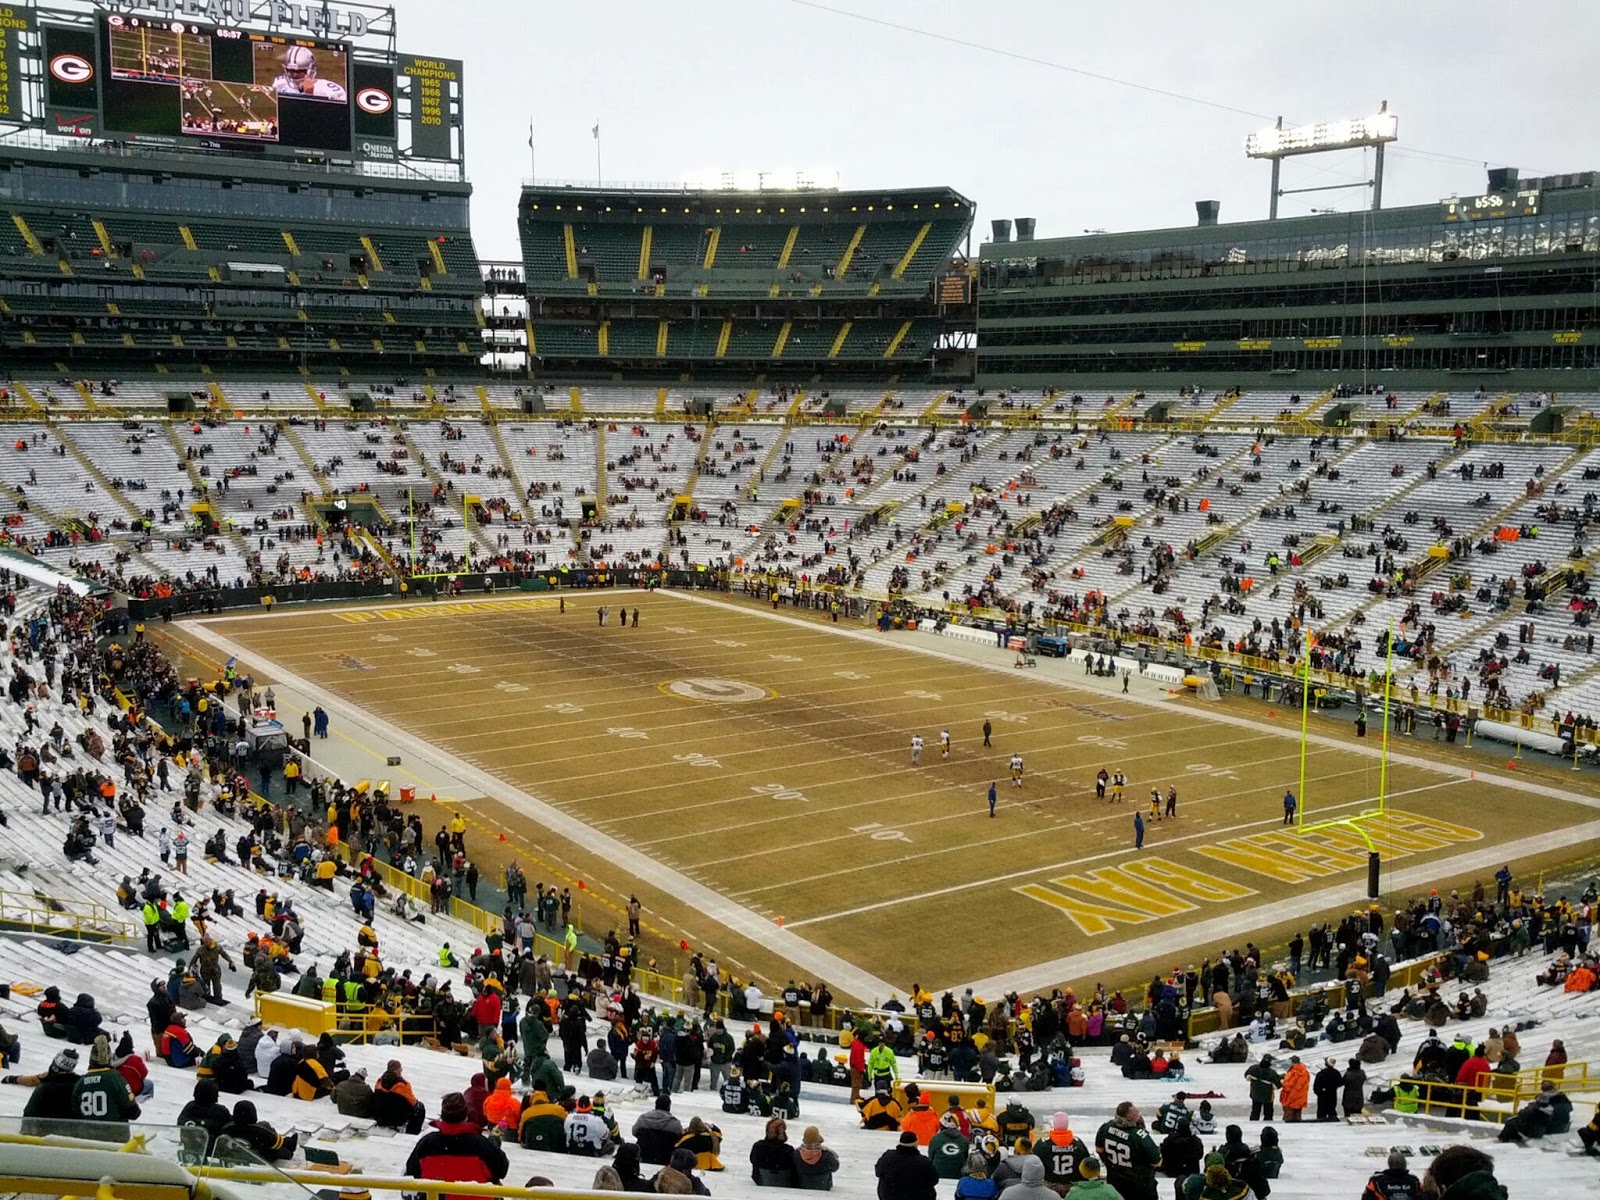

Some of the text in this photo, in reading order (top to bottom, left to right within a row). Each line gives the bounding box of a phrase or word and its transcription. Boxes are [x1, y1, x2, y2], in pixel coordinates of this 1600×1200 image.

[101, 0, 368, 36] BEAU FIELD
[414, 59, 446, 69] WORLD
[403, 66, 457, 80] CHAMPIONS
[421, 78, 441, 87] 1965
[421, 88, 441, 96] 1966
[421, 97, 440, 106] 1967
[421, 107, 441, 115] 1996
[421, 116, 441, 125] 2010
[57, 125, 92, 136] verizon
[362, 142, 393, 154] ONEIDA
[370, 151, 394, 160] NATION
[673, 752, 712, 766] 30
[750, 783, 804, 800] 20
[849, 822, 906, 841] 10
[1010, 808, 1485, 936] GREEN BAY
[921, 1008, 933, 1018] 52
[80, 1091, 108, 1117] 80
[570, 1122, 588, 1139] 12
[942, 1143, 960, 1155] G
[1104, 1139, 1133, 1168] 52
[1052, 1154, 1074, 1176] 12
